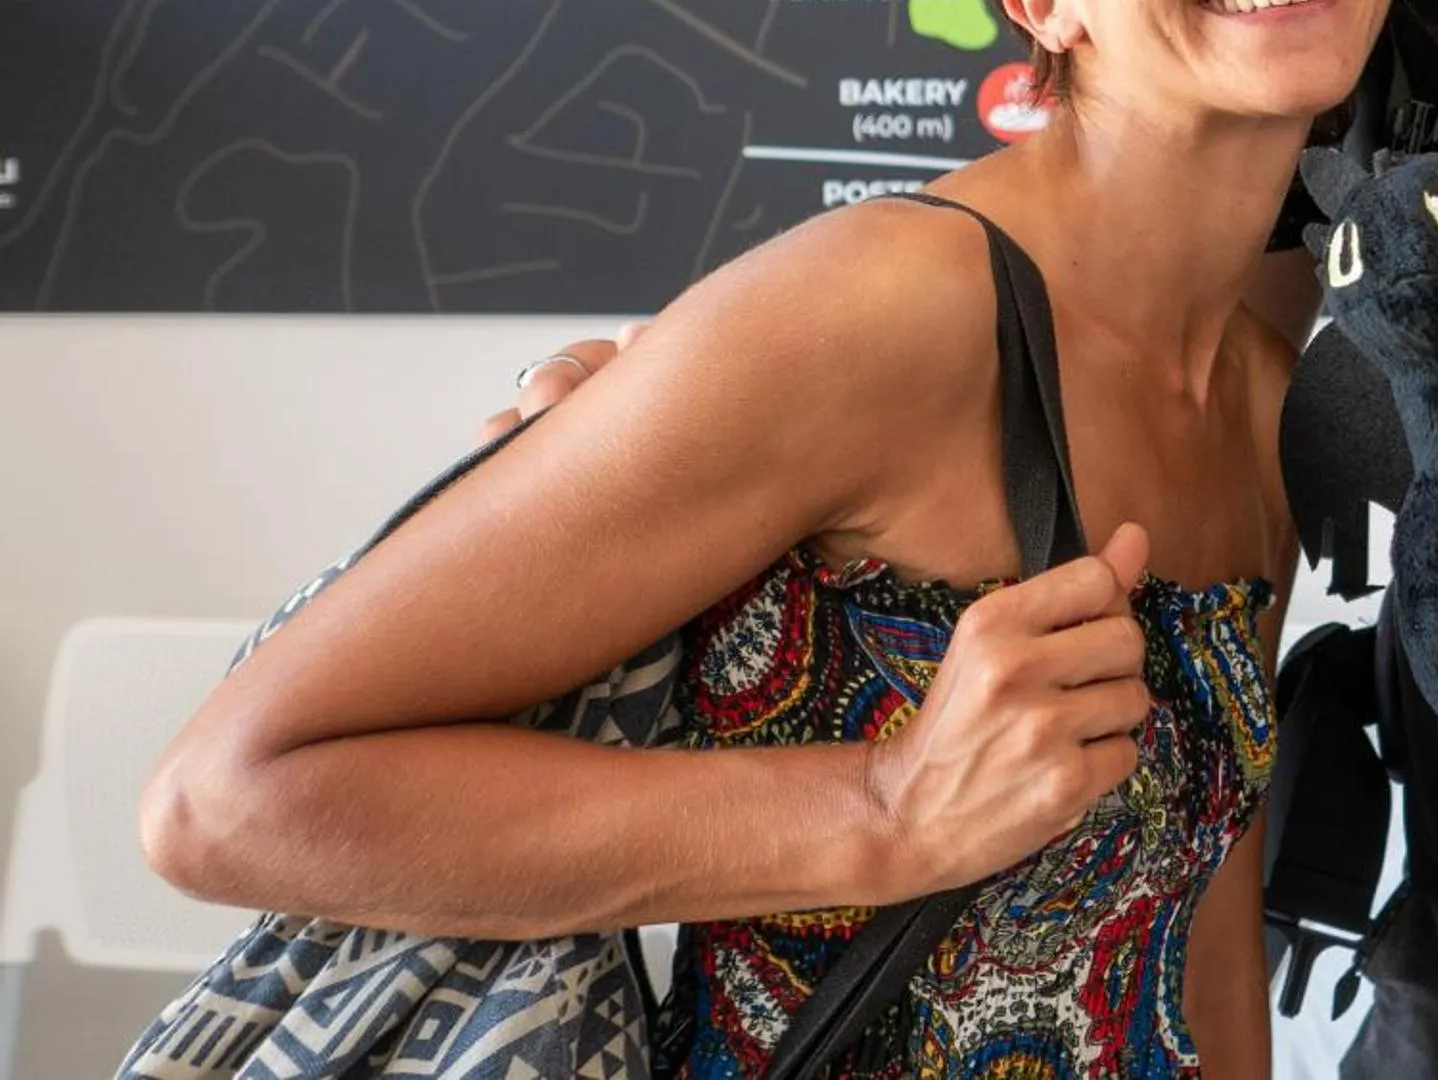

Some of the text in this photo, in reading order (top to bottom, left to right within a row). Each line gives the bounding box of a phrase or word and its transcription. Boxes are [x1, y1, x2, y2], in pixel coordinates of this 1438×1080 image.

[839, 79, 966, 106] BAKERY
[853, 114, 953, 142] (400 m)
